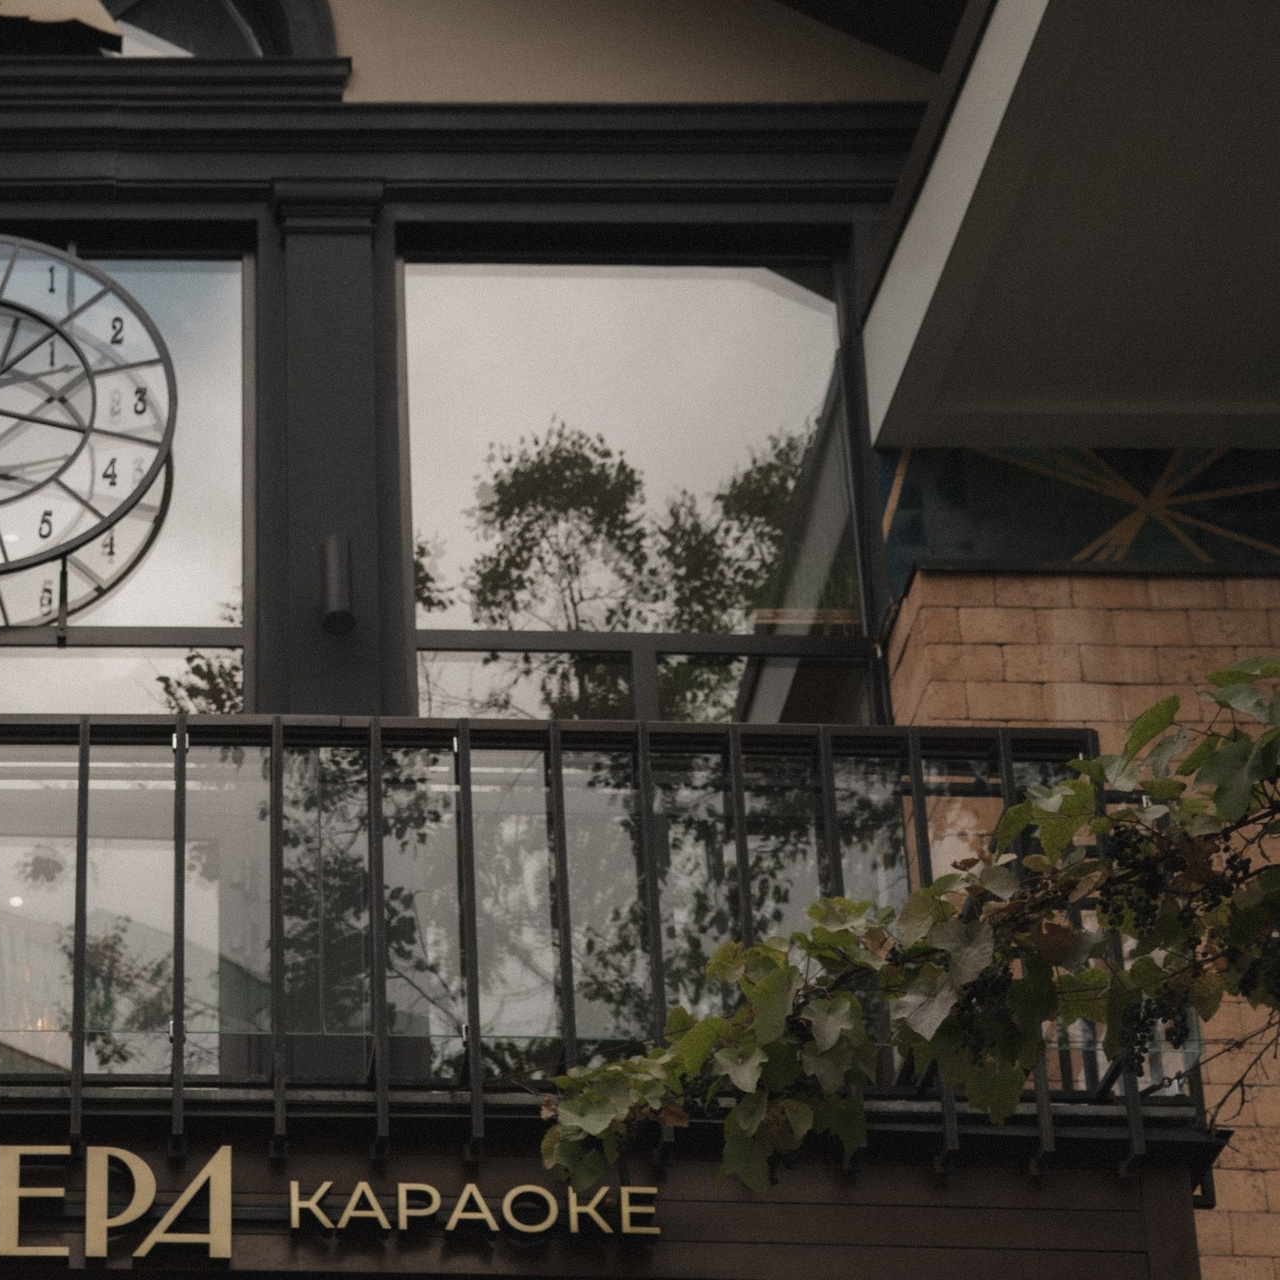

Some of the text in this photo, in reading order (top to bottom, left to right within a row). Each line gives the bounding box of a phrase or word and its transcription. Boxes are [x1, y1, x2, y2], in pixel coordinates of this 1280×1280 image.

[48, 265, 56, 293] 1
[111, 317, 124, 345] 2
[134, 387, 148, 415] 3
[102, 457, 118, 487] 4
[38, 510, 53, 539] 5
[289, 1180, 662, 1235] КАРАОКЕ
